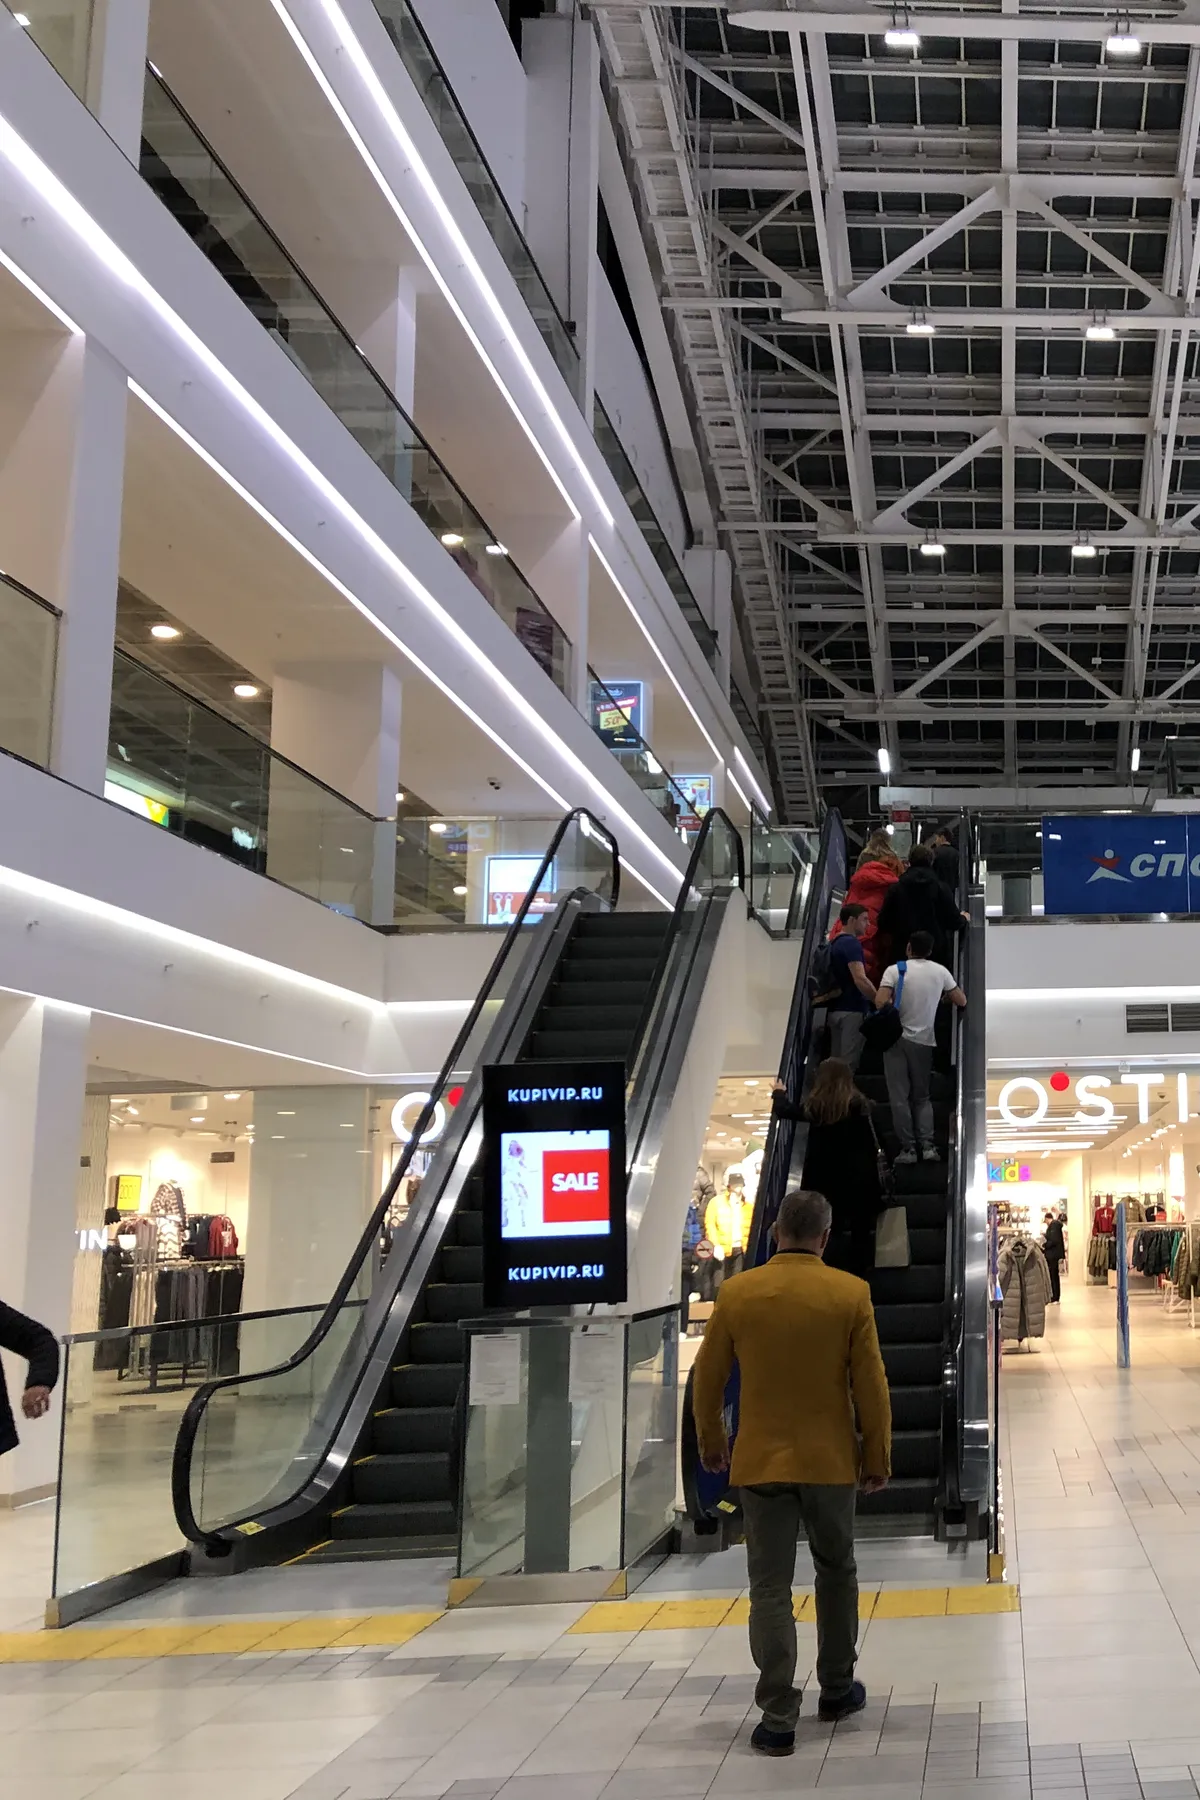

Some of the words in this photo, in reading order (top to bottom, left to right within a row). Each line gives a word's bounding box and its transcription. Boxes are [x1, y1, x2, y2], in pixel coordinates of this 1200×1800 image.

[507, 1086, 603, 1103] KUPIVIP.RU
[987, 1161, 1031, 1182] kids
[552, 1171, 599, 1192] SALE
[508, 1264, 604, 1281] KUPIVIP.RU
